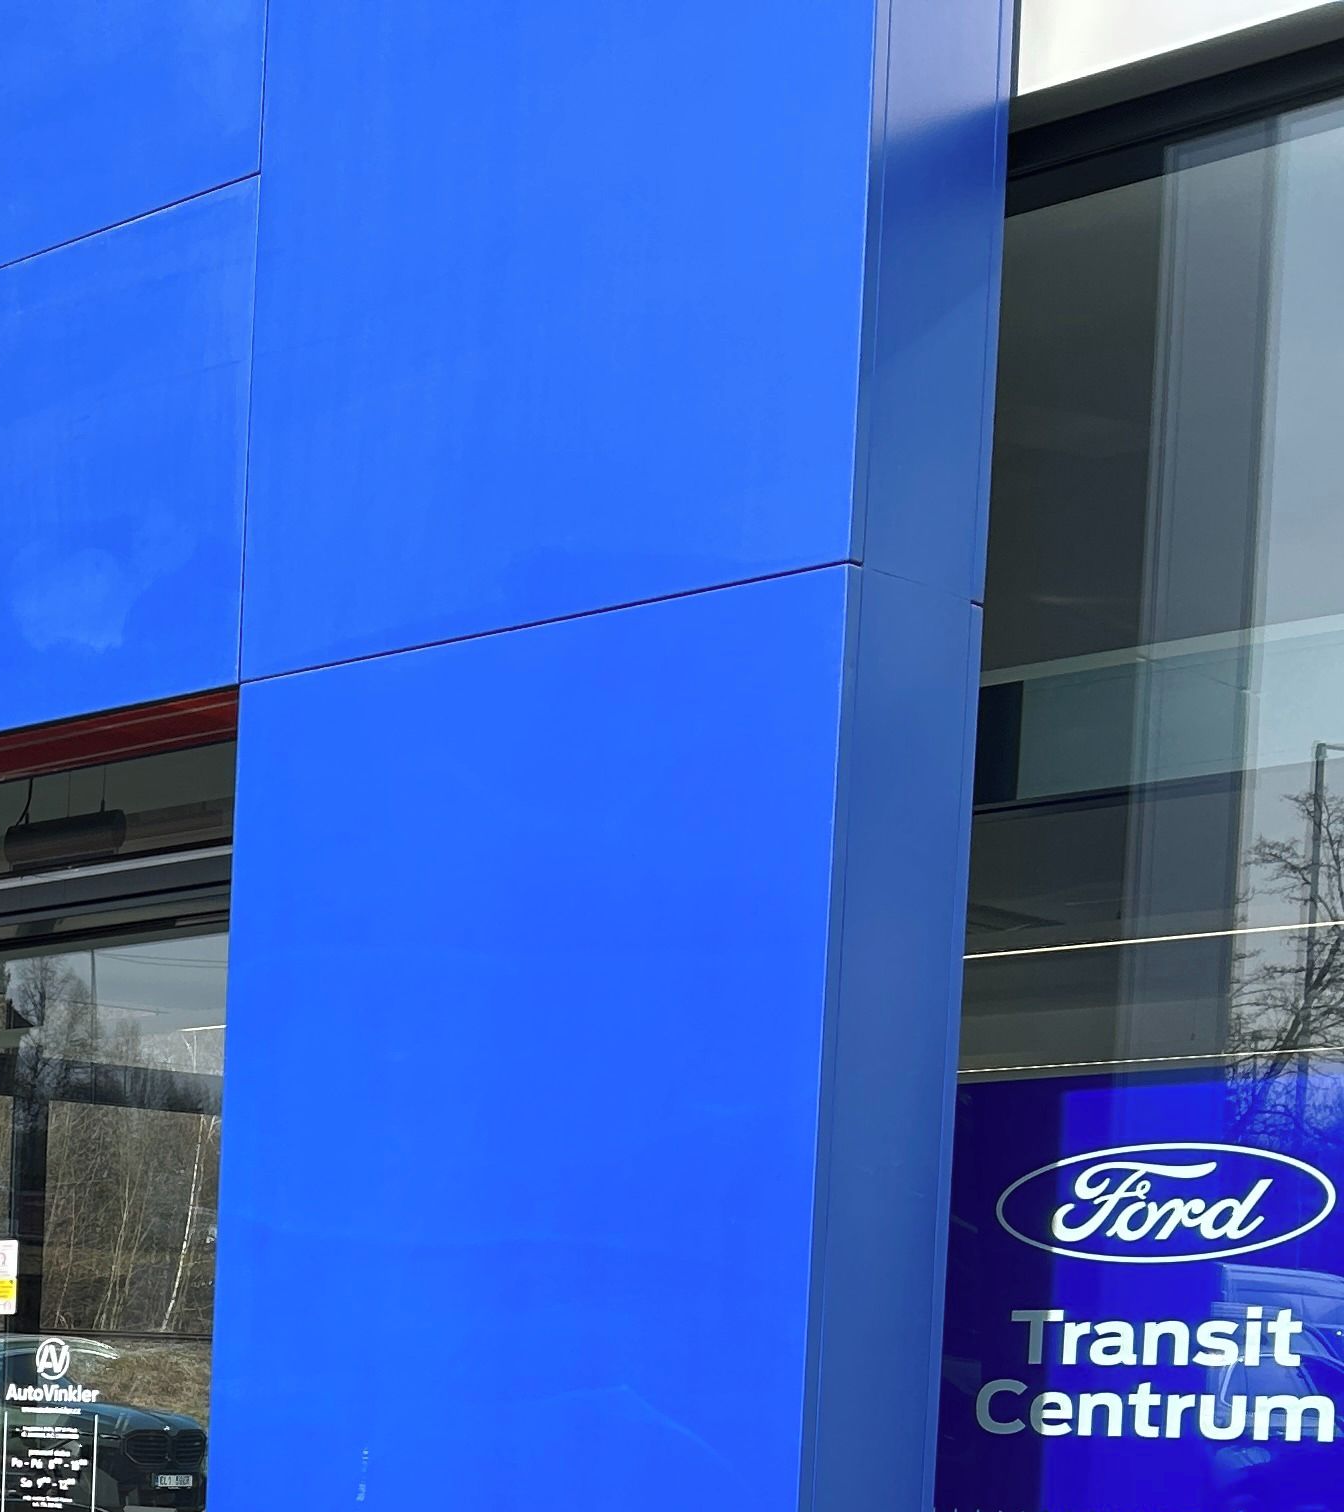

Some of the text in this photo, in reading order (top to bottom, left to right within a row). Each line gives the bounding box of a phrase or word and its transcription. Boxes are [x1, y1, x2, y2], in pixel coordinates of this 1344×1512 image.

[1051, 1160, 1273, 1242] Ford
[1011, 1306, 1302, 1368] Transit
[5, 1383, 100, 1403] AutoVinkler
[975, 1379, 1334, 1443] Centrum
